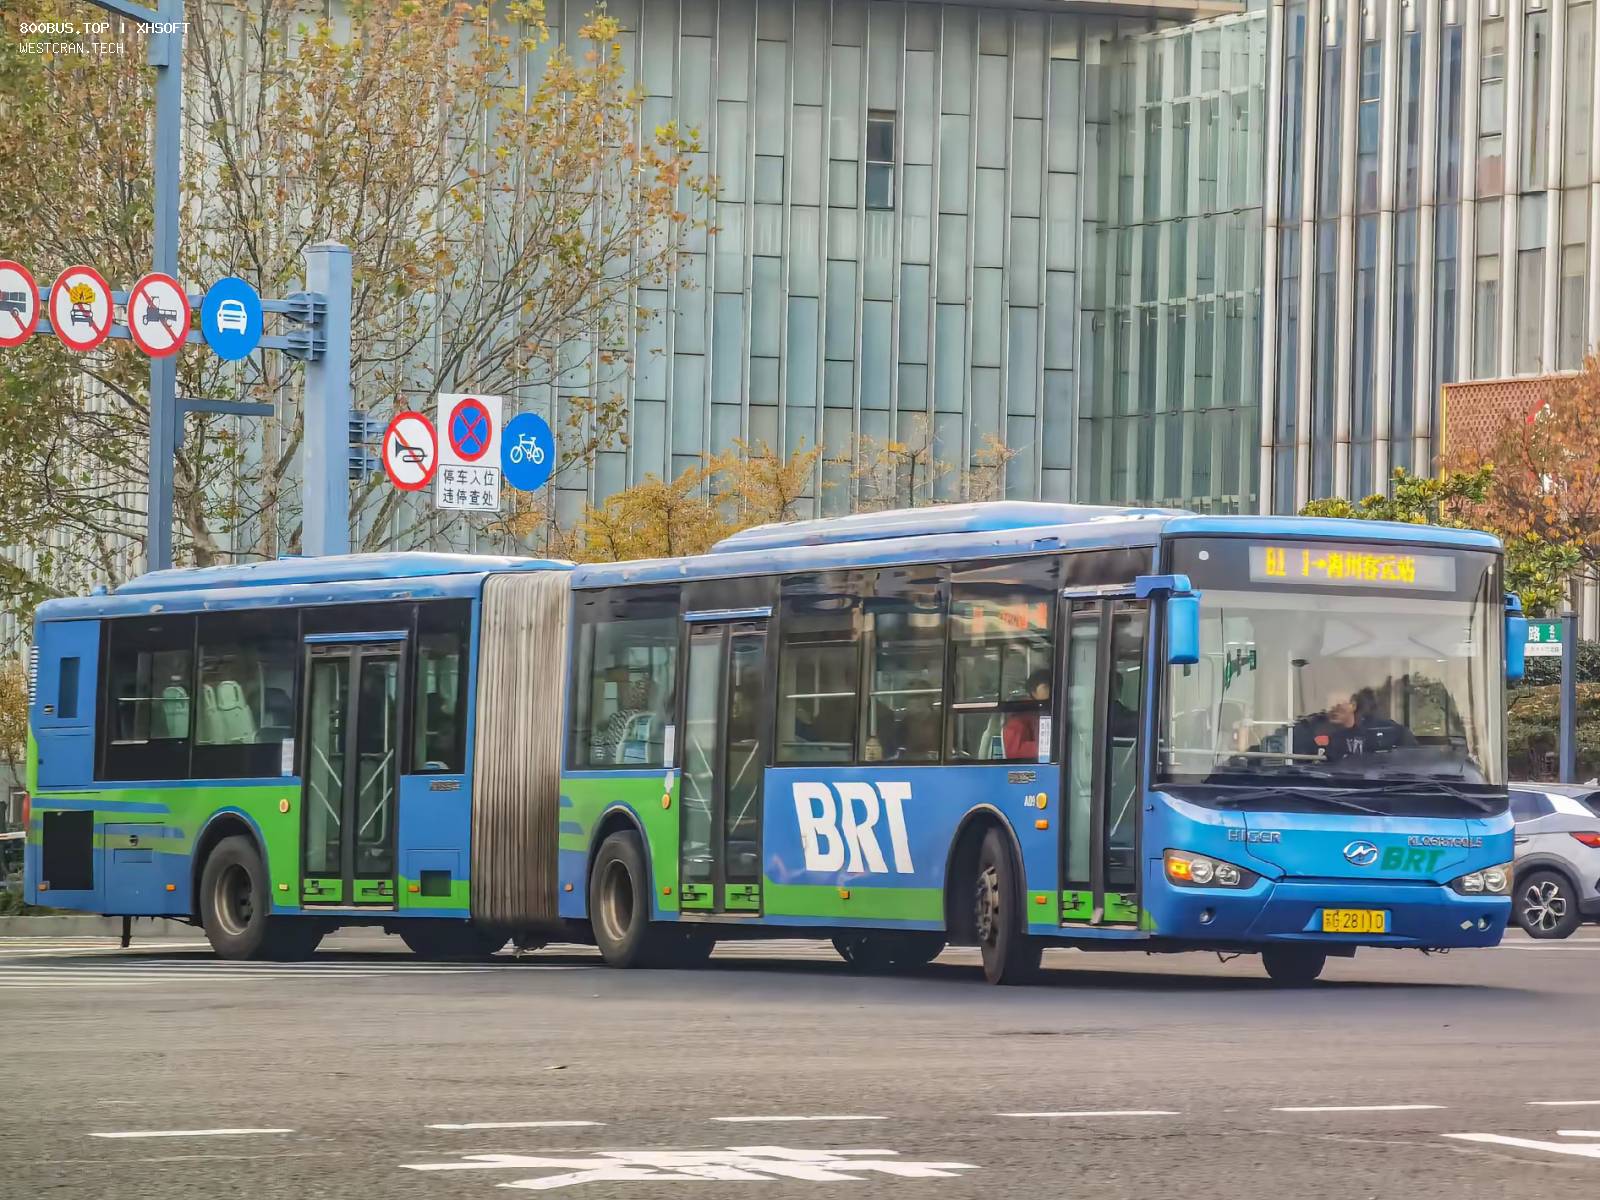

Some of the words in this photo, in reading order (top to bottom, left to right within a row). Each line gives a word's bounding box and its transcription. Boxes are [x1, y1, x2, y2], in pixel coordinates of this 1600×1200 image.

[443, 469, 495, 487] 停车入位
[442, 488, 494, 507] 违停查处
[791, 781, 915, 874] BRT
[1228, 829, 1281, 844] HIGER
[1381, 845, 1446, 874] BRT
